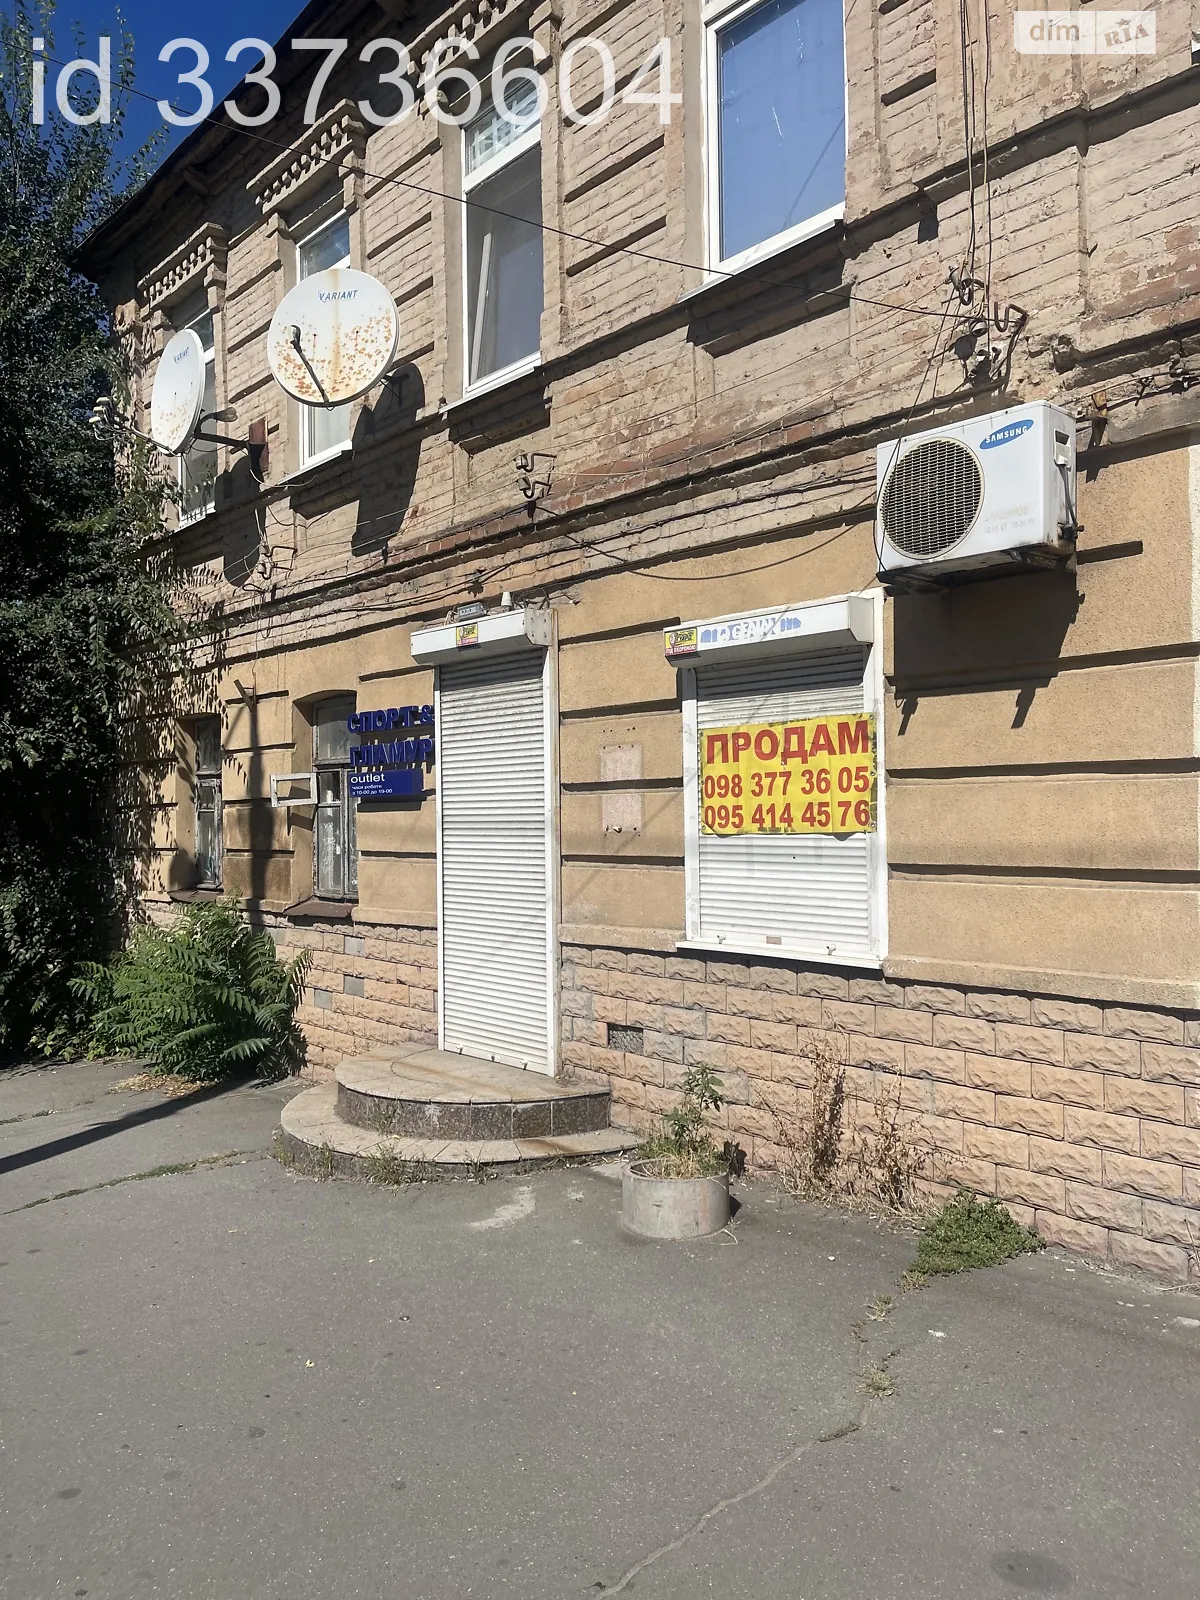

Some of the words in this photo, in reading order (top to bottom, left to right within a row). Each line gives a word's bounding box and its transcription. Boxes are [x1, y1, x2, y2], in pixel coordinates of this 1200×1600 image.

[318, 290, 358, 303] VARIANT
[985, 425, 1028, 443] SAMSUNG
[347, 705, 413, 734] СПОРТ
[420, 705, 435, 723] &
[349, 738, 433, 767] ГЛАМУР
[706, 719, 869, 766] ПРОДАМ
[350, 773, 385, 784] outlet
[704, 773, 743, 799] 098
[750, 770, 792, 798] 377
[800, 768, 831, 795] 36
[838, 766, 870, 794] 05
[704, 804, 744, 830] 095
[751, 802, 794, 829] 414
[801, 801, 831, 828] 45
[837, 799, 870, 827] 76
